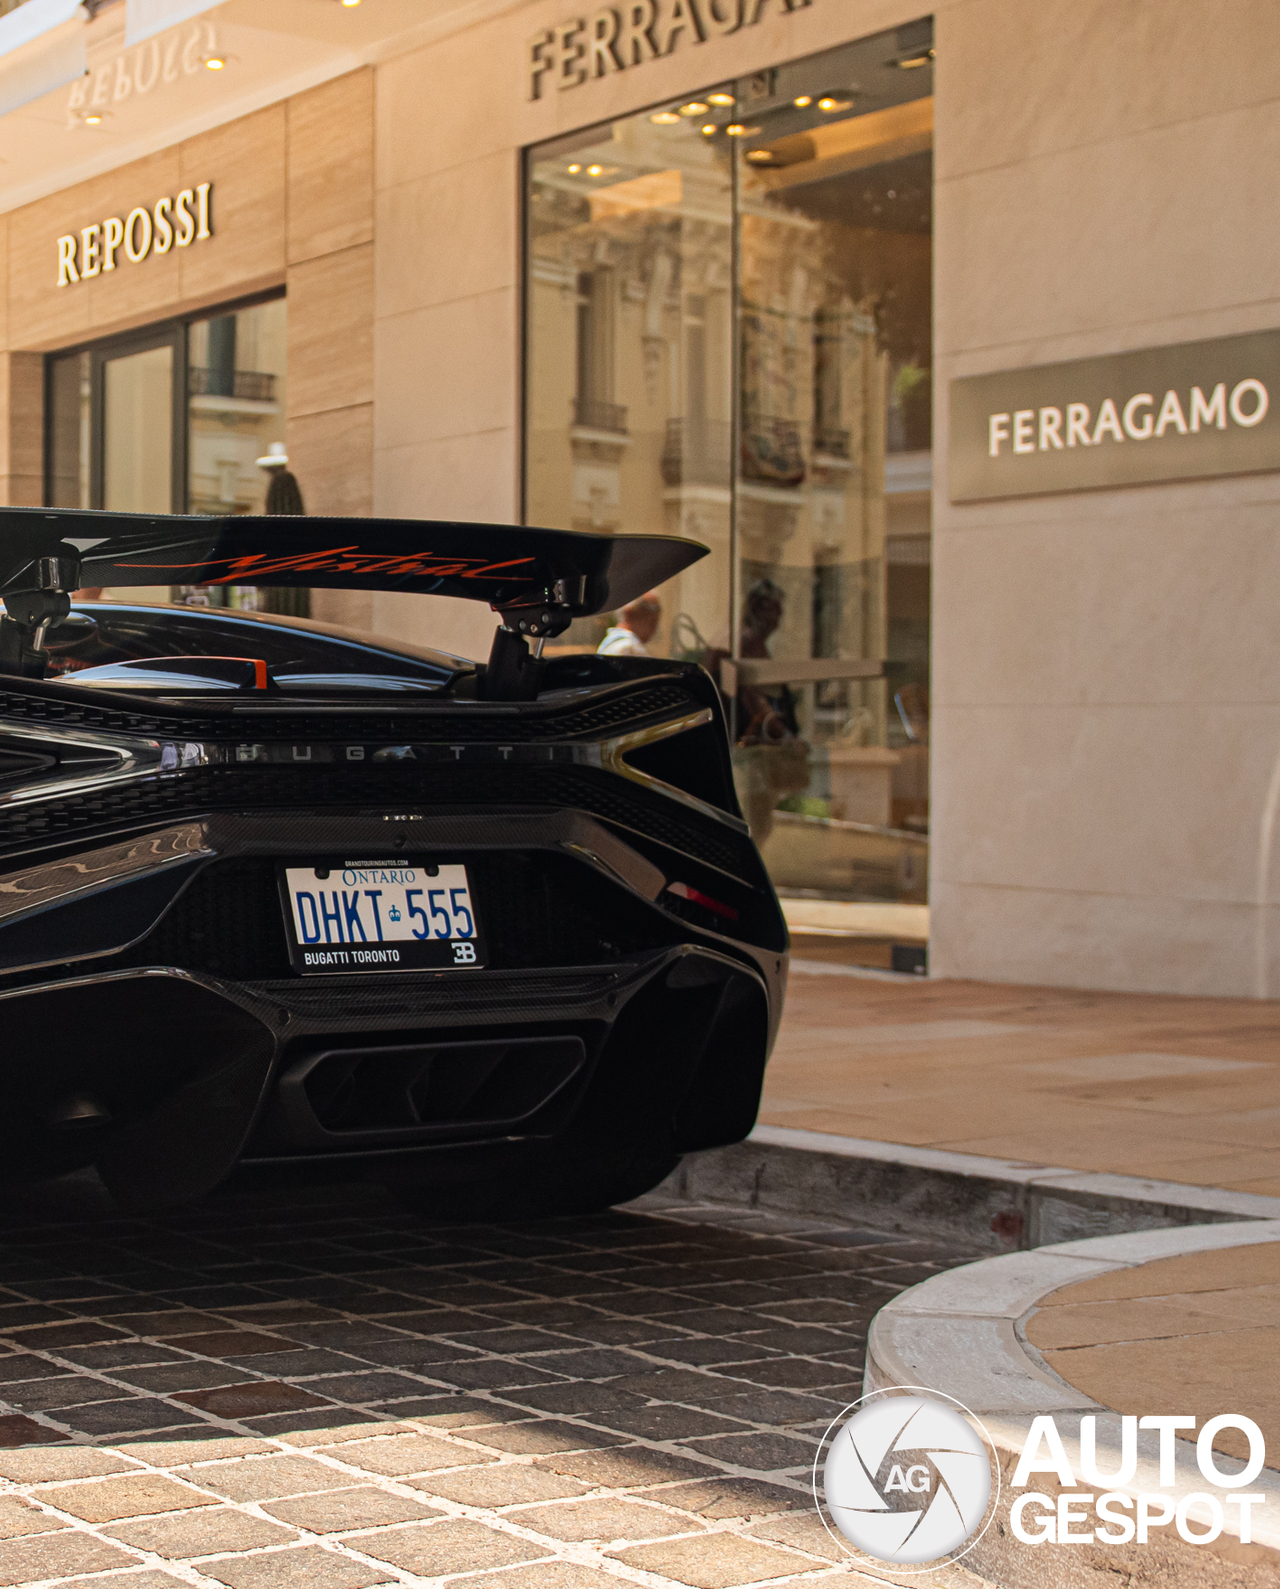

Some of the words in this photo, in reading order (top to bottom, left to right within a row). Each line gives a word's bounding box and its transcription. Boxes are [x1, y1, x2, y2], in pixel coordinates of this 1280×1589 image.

[56, 182, 213, 287] REPOSSI
[988, 378, 1269, 457] FERRAGAMO
[296, 890, 384, 944] DHKT
[405, 888, 474, 940] 555
[304, 951, 350, 965] BUGATTI
[351, 950, 401, 963] TORONTO
